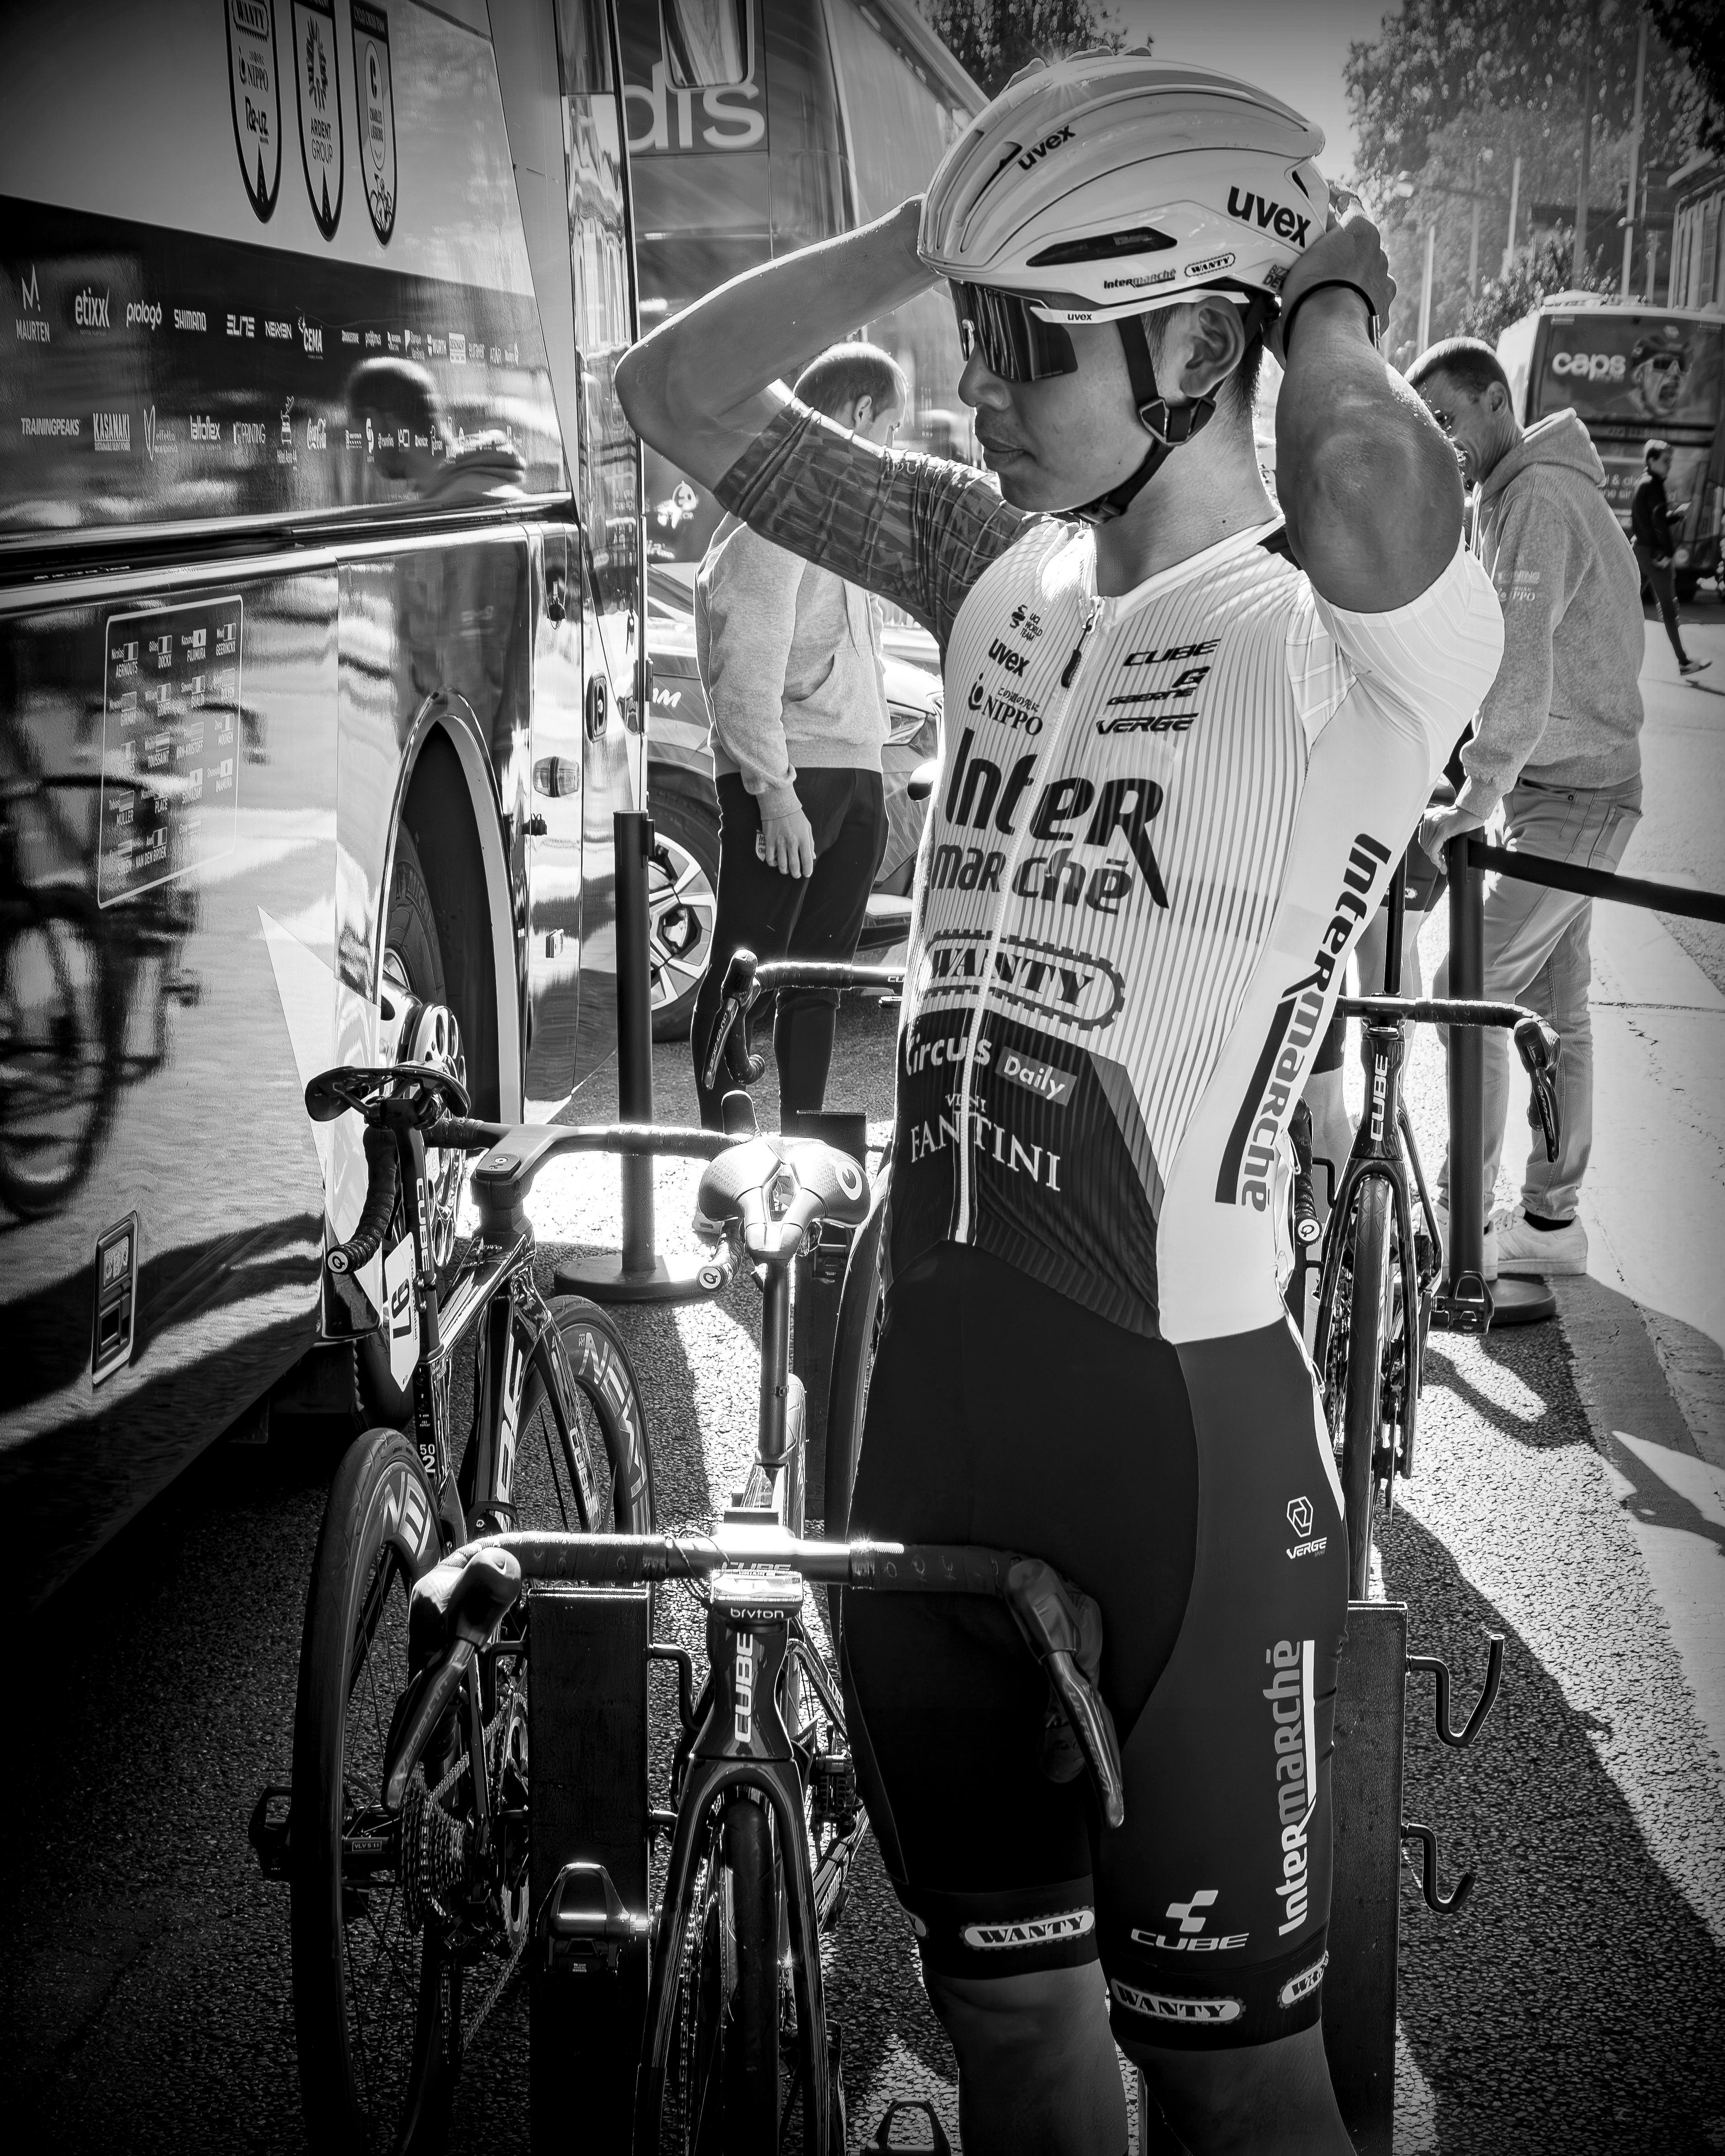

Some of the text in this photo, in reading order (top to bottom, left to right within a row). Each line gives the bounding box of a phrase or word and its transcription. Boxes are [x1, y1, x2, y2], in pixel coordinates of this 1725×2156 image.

[247, 62, 269, 93] NIPPO
[311, 117, 332, 142] ARDENT
[312, 138, 333, 165] GROUP
[1018, 125, 1075, 170] uvex
[1228, 185, 1311, 248] uvex
[1191, 256, 1230, 273] WANTY
[126, 299, 162, 331] prologo
[174, 308, 206, 332] SHIMANO
[227, 314, 254, 338] ELITE
[1068, 312, 1092, 321] uvex
[16, 317, 50, 343] MAURTEN
[304, 327, 323, 354] CEMA
[1553, 352, 1626, 381] caps
[21, 417, 81, 436] TRAININGPEAKS
[93, 412, 130, 440] KASANAKI
[190, 415, 221, 440] lattoflex
[1020, 628, 1035, 642] TEAM
[1025, 620, 1043, 637] WORLD
[111, 648, 124, 661] Nicolas
[158, 654, 172, 669] DOCKX
[187, 647, 206, 663] FUJIMURA
[989, 637, 1030, 677] uvex
[1124, 638, 1222, 666] CUBE
[116, 661, 138, 678] AERNOUTS
[982, 694, 1043, 736] NIPPO
[1096, 713, 1199, 735] VERGE
[148, 750, 170, 768] TOUSSAINT
[155, 798, 168, 814] PLACE
[136, 853, 144, 869] VAN
[144, 848, 153, 865] DEN
[153, 844, 167, 862] BROEK
[931, 949, 1095, 1007] WANTY
[905, 1033, 992, 1076] Circus
[1003, 1055, 1066, 1099] Daily
[1370, 1053, 1389, 1141] CUBE
[910, 1110, 1061, 1191] FANTINI
[416, 1178, 430, 1272] CUBE
[420, 1444, 435, 1455] 50
[423, 1455, 435, 1473] 2
[1286, 1537, 1327, 1559] VERGE
[735, 1633, 753, 1743] CUBE
[977, 1914, 1085, 1944] WANTY
[1131, 1928, 1249, 1951] CUBE
[1116, 1982, 1229, 2018] WANTY
